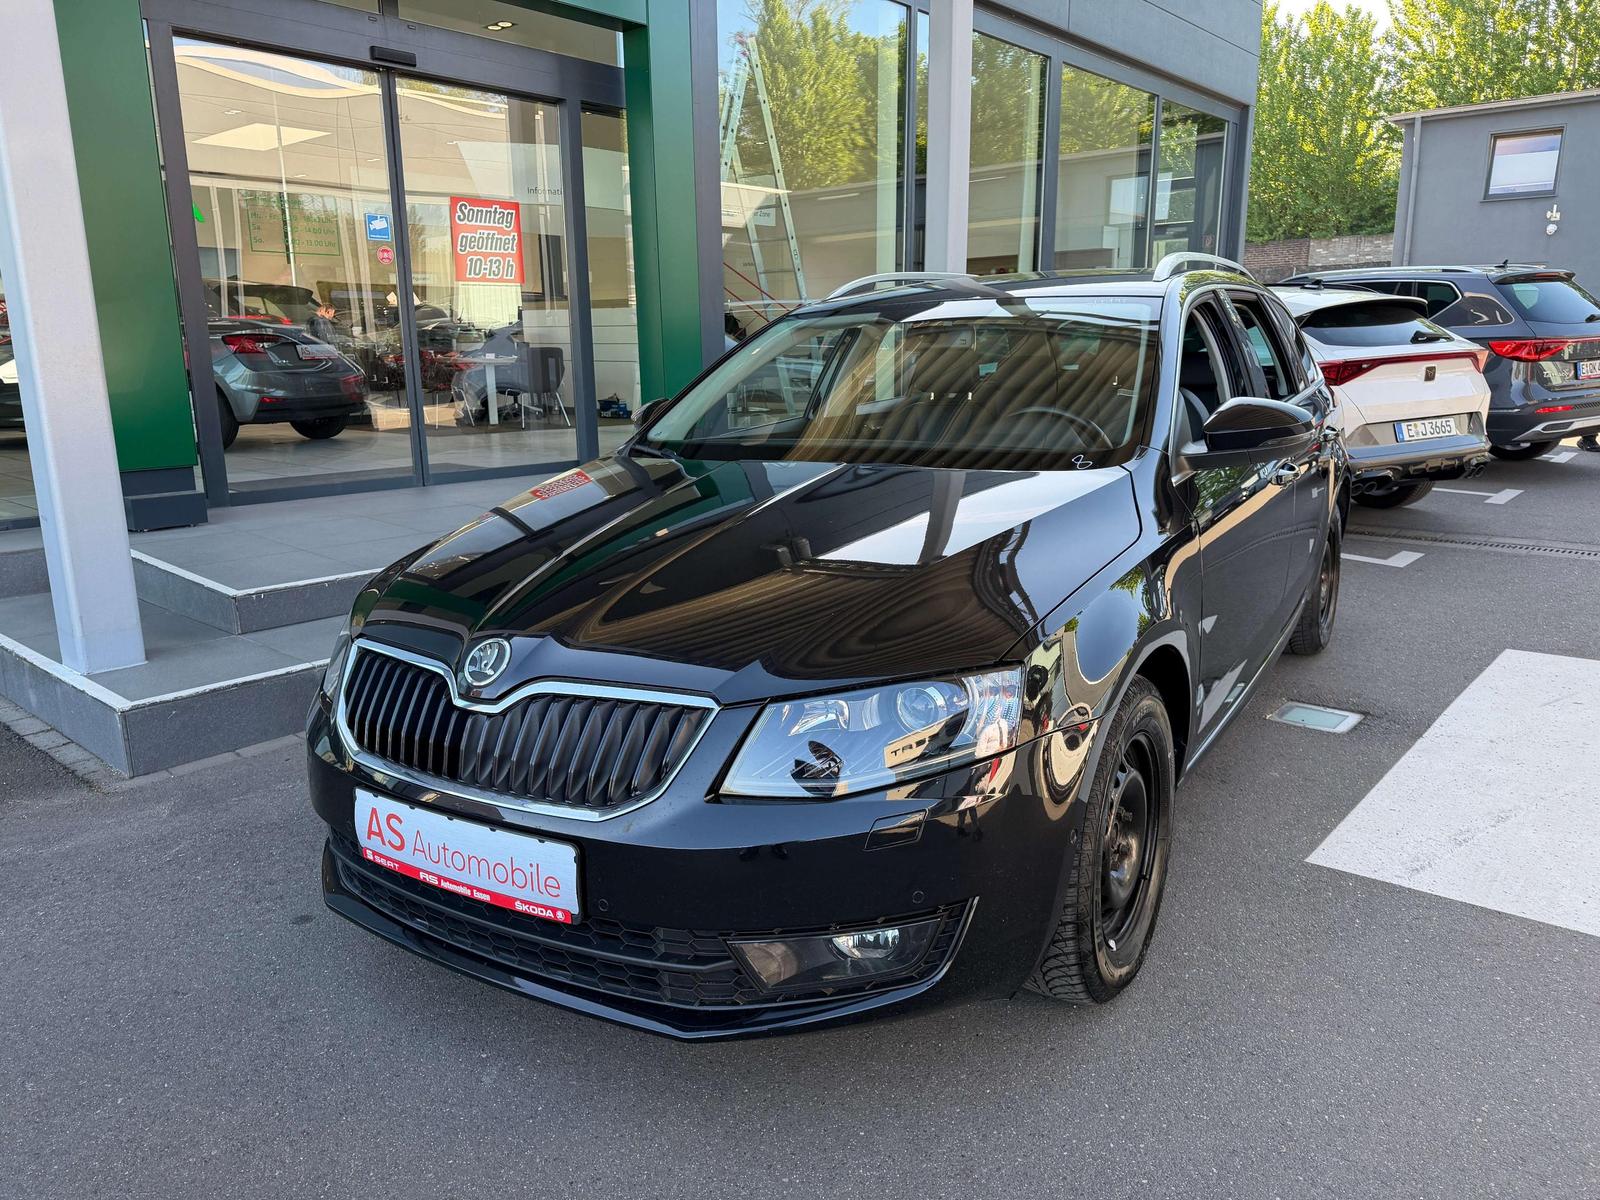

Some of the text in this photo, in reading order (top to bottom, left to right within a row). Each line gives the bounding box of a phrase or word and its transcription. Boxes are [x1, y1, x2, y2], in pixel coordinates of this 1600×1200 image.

[457, 202, 514, 229] Sonntag
[459, 231, 517, 252] geöffnet
[466, 257, 515, 278] 10-13 h
[1406, 424, 1414, 438] E
[366, 806, 561, 899] AS Automobile
[374, 855, 400, 870] SEAT
[440, 879, 471, 896] Automobile
[514, 900, 555, 919] ŠKODA
